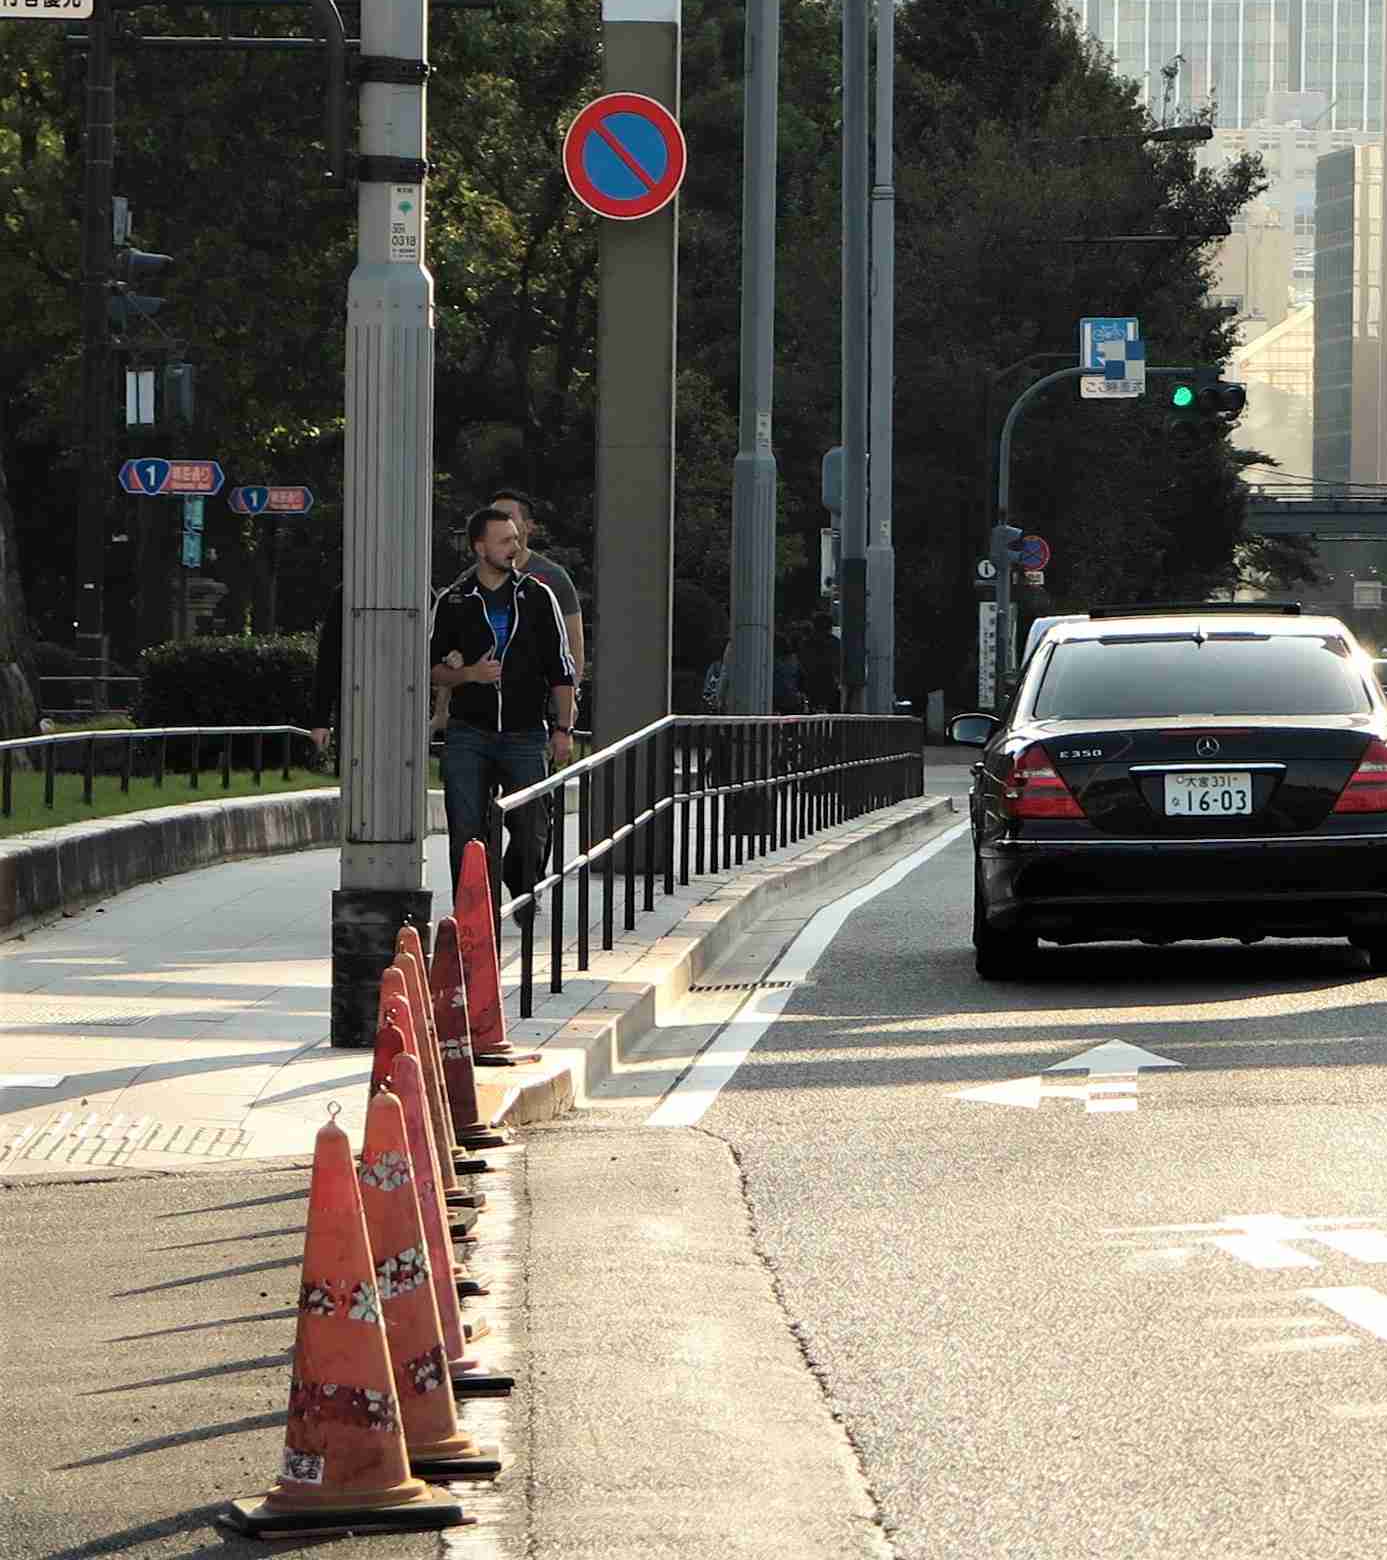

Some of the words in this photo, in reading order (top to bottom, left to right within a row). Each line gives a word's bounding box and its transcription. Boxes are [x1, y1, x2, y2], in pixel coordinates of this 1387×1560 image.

[145, 464, 156, 487] 1
[249, 490, 258, 507] 1
[1187, 789, 1247, 812] 16-03
